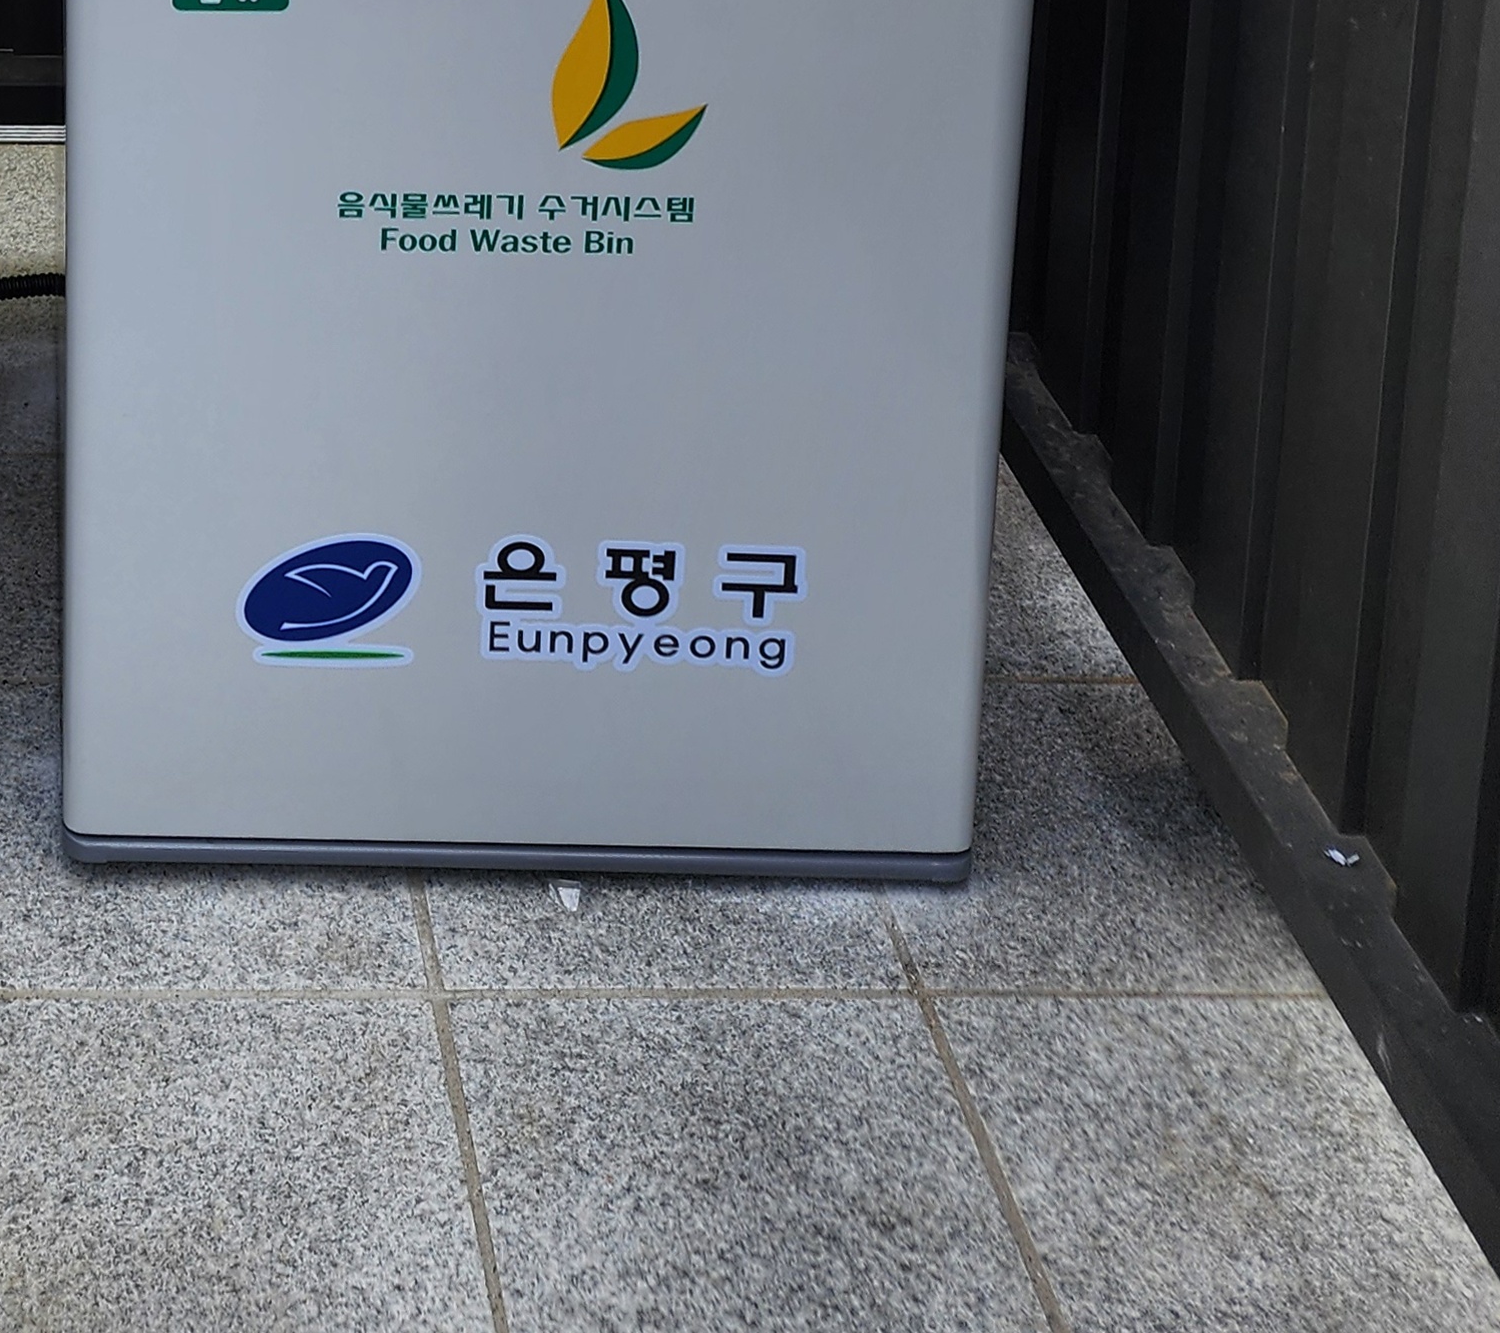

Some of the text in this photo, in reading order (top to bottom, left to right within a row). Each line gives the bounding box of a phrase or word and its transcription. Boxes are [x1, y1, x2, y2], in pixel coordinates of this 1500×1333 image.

[337, 191, 695, 223] 음식물쓰레기 수거시스템
[380, 227, 634, 255] Food Waste Bin
[483, 541, 798, 619] 은평구
[488, 621, 787, 670] Eunpyeong
